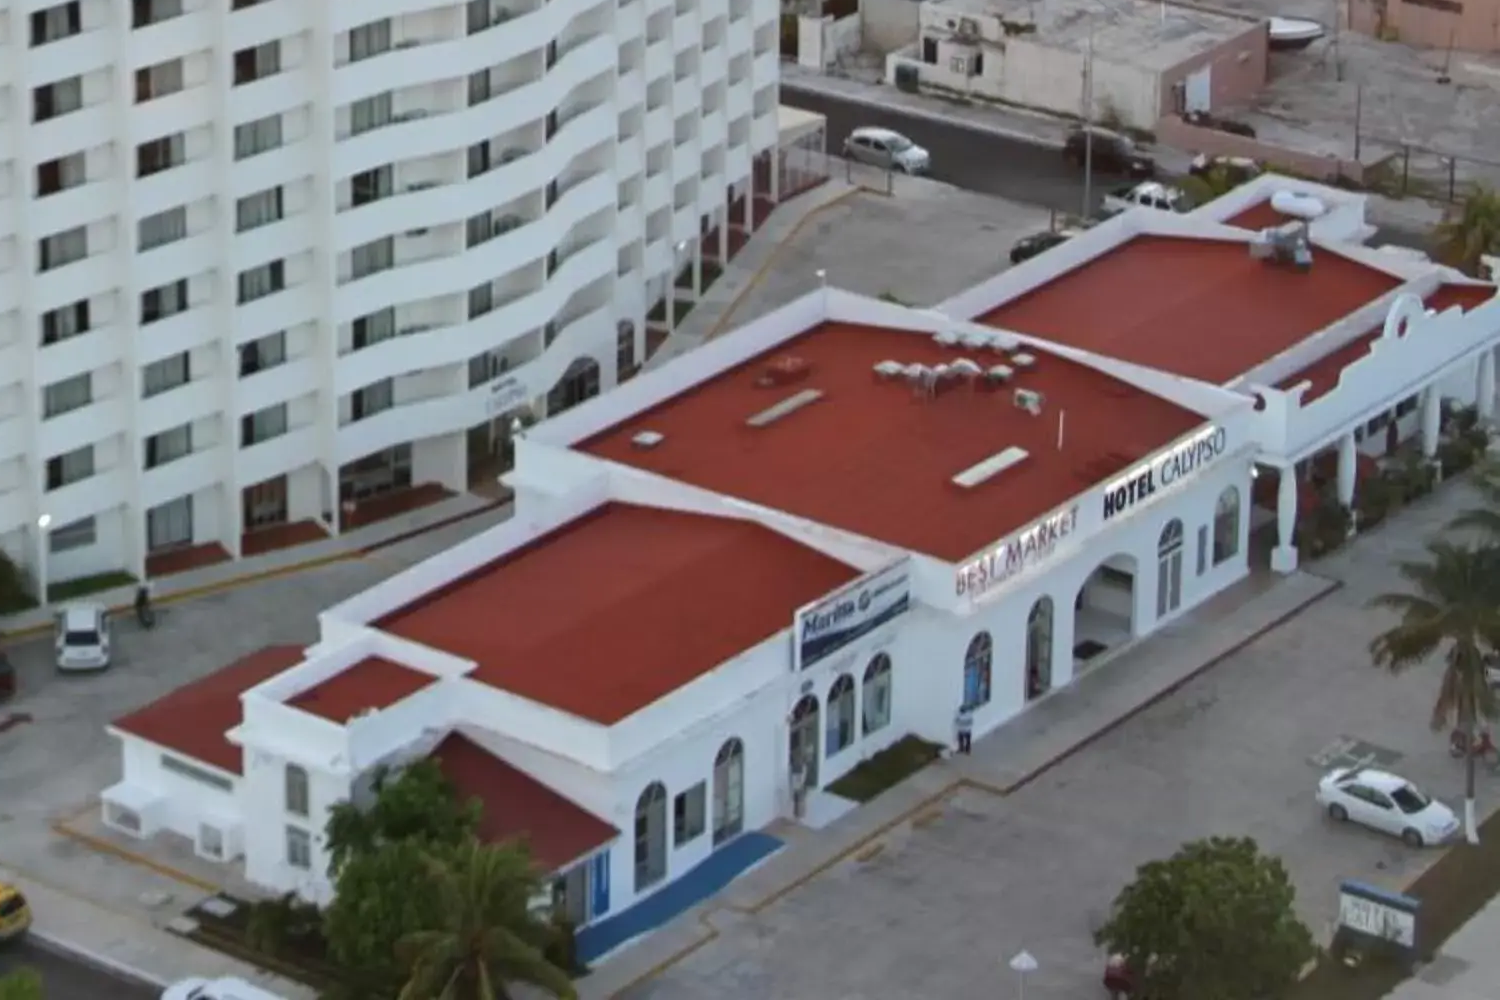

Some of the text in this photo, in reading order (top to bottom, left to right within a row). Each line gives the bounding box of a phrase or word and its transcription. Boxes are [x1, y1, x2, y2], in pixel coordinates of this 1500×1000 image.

[1103, 427, 1226, 520] HOTEL CALYPSO
[956, 555, 998, 595] BEST
[1006, 505, 1079, 569] MARKET
